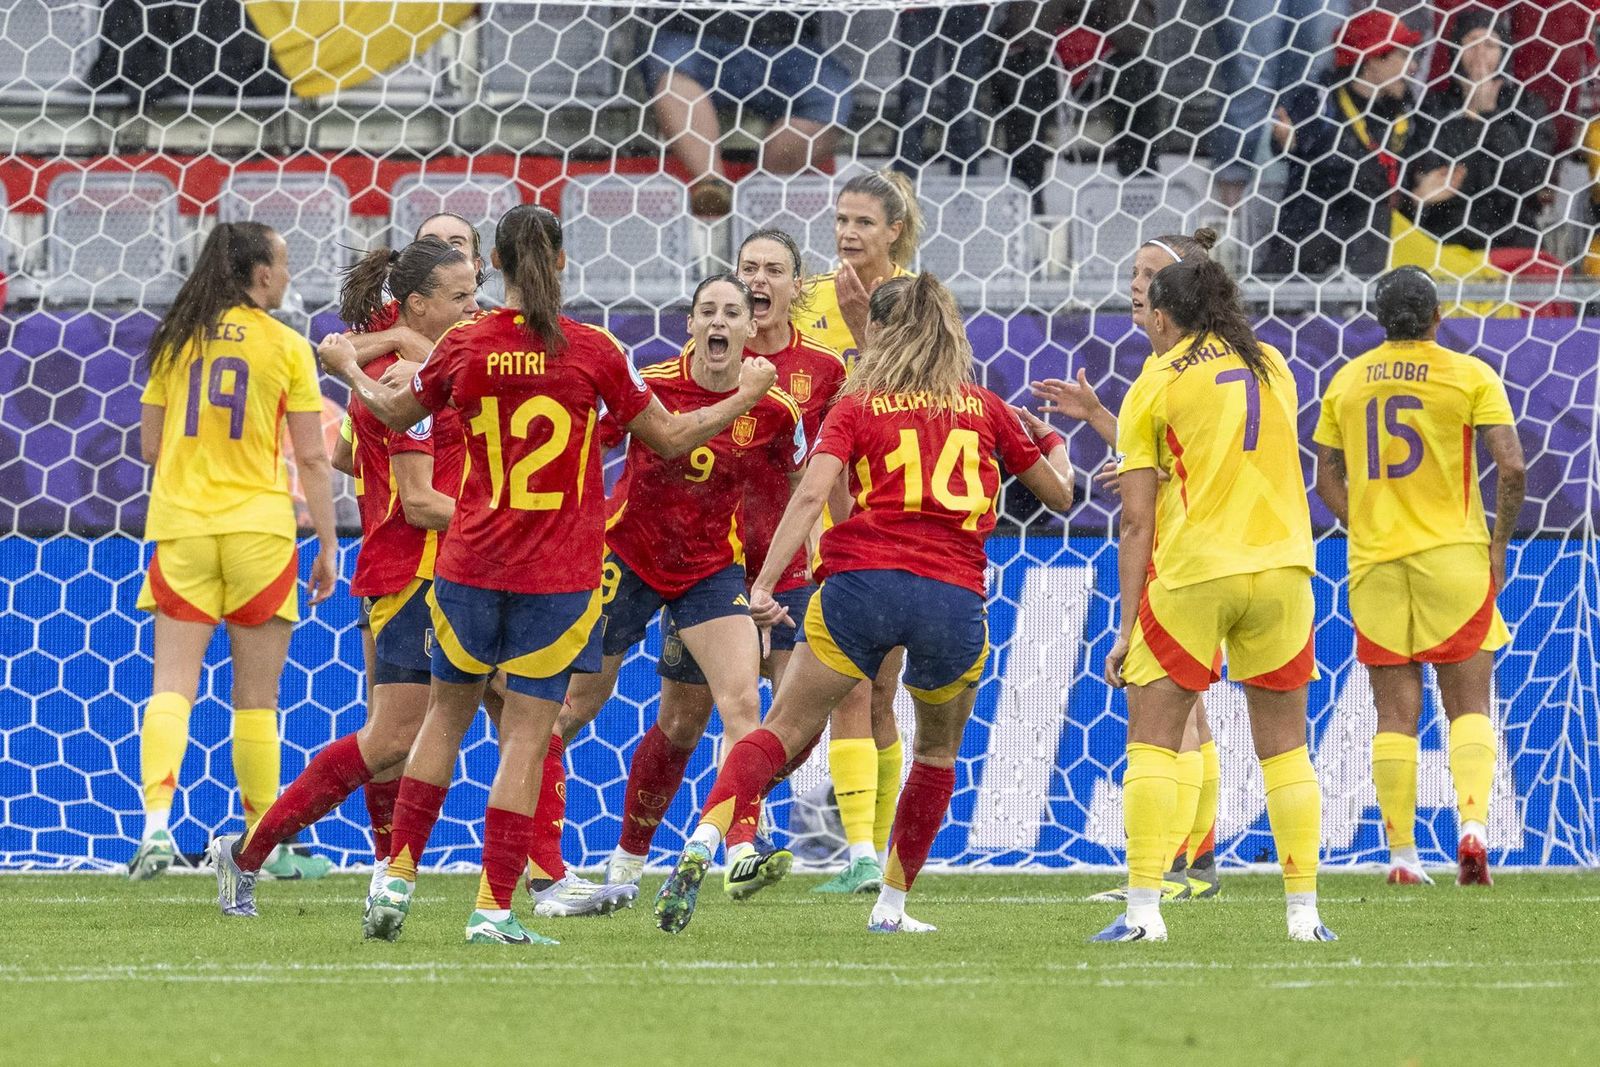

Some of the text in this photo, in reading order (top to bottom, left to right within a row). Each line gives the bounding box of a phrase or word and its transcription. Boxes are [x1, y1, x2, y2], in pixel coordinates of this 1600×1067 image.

[184, 356, 249, 440] 19
[487, 351, 545, 375] PATRI
[1366, 361, 1429, 383] TOLOBA
[1215, 368, 1260, 451] 7
[1366, 395, 1424, 480] 15
[469, 395, 572, 511] 12
[685, 446, 715, 483] 9
[884, 429, 992, 531] 14
[601, 561, 622, 605] 9
